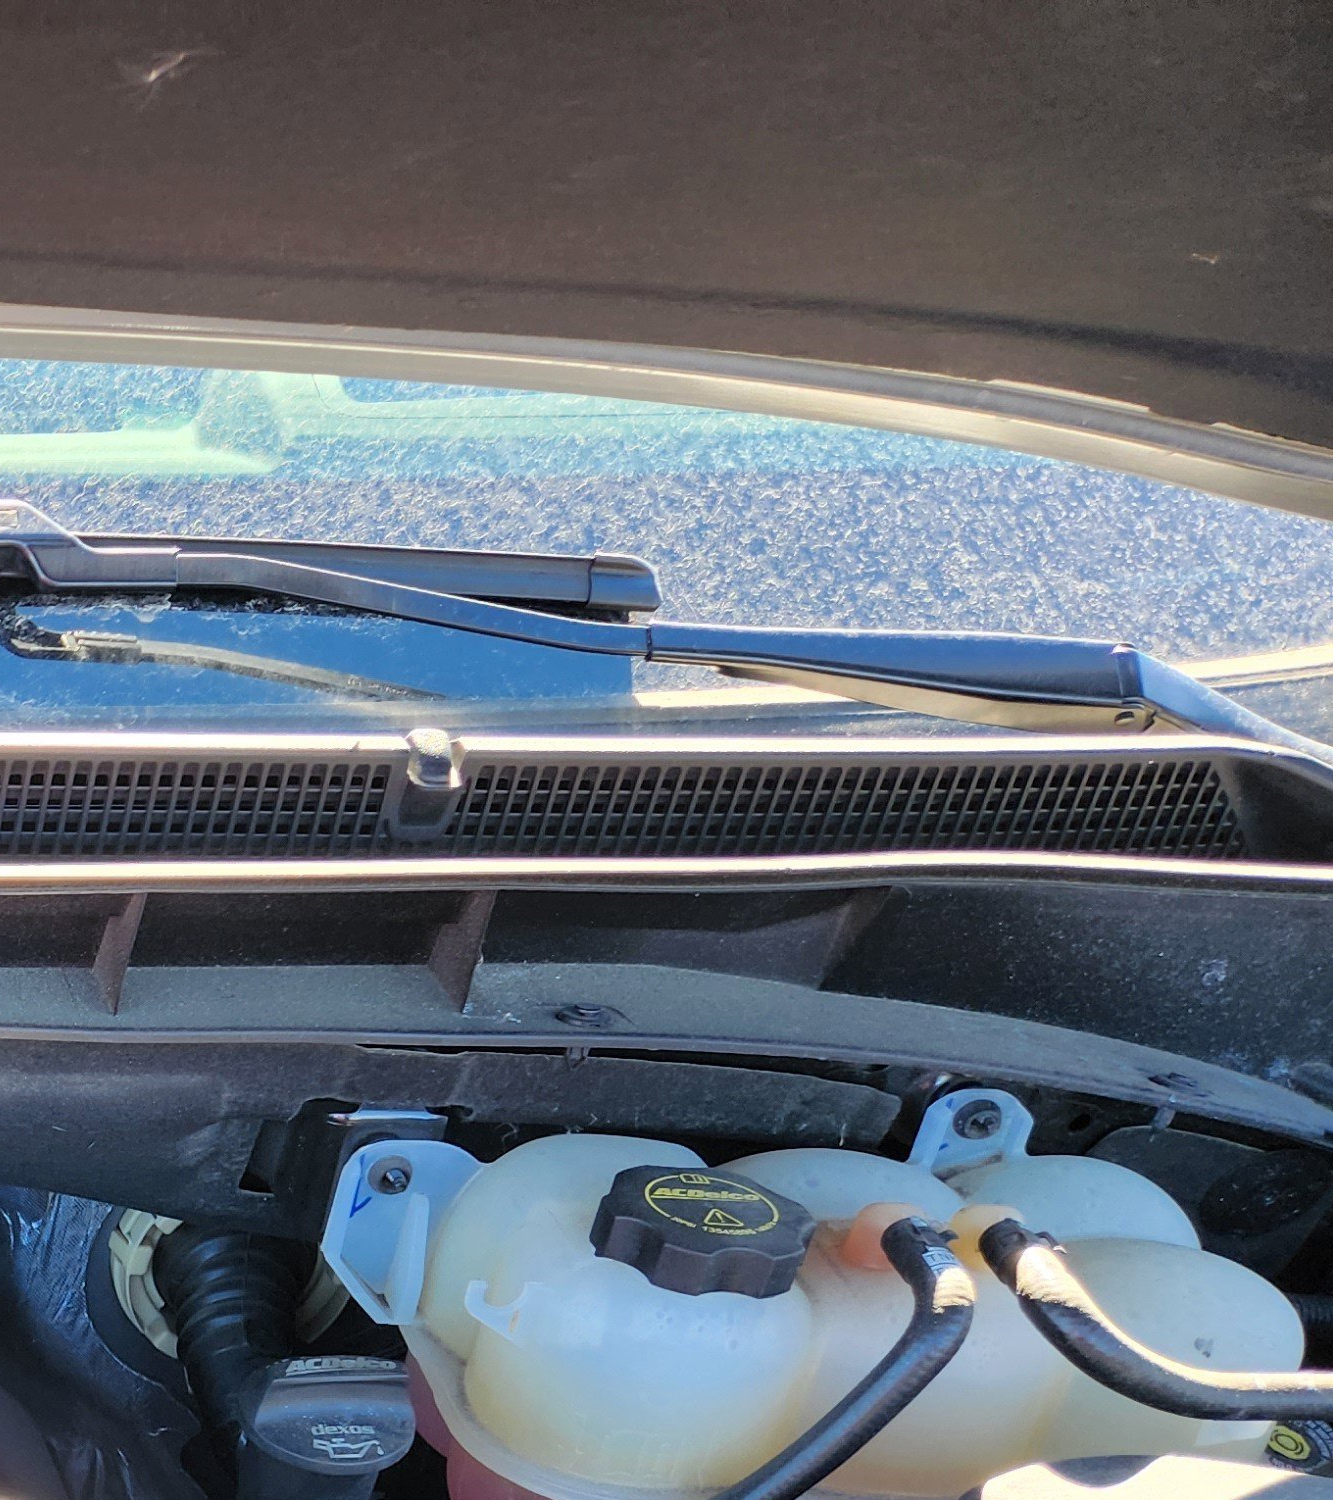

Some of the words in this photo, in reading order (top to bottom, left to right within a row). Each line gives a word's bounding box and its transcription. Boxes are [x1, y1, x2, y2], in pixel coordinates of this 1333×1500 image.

[652, 1187, 761, 1201] ACDelco
[286, 1357, 397, 1372] ACDelco
[311, 1424, 376, 1436] dexos
